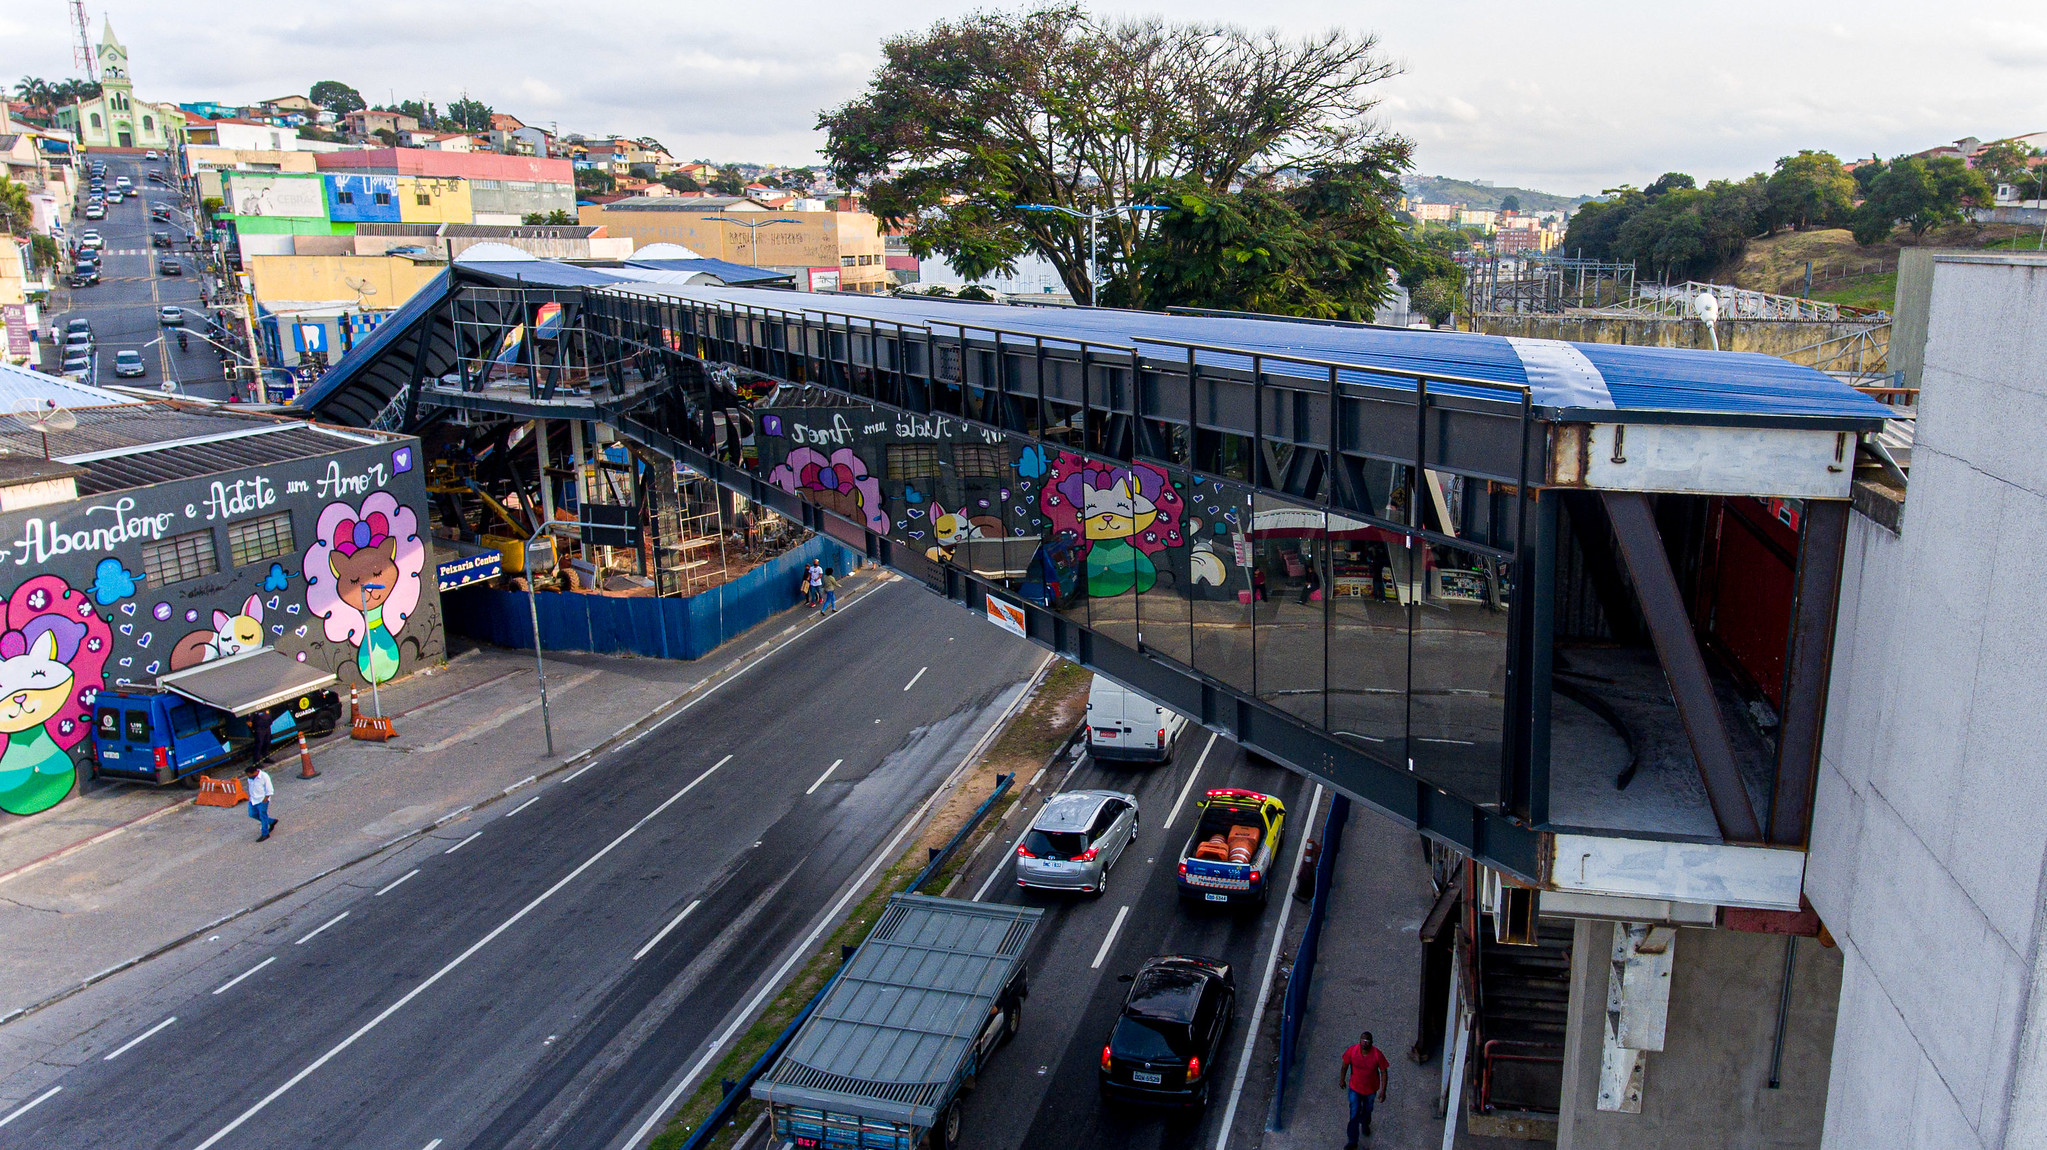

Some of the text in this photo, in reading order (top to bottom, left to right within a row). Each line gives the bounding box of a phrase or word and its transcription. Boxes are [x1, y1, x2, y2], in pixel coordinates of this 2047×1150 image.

[277, 194, 318, 204] CEBRAC
[14, 460, 388, 565] Abandono e Adote um Amor
[440, 553, 500, 576] Peixaria Central
[256, 685, 318, 710] GUARDA MUNICIPAL
[295, 707, 316, 718] GUARDA
